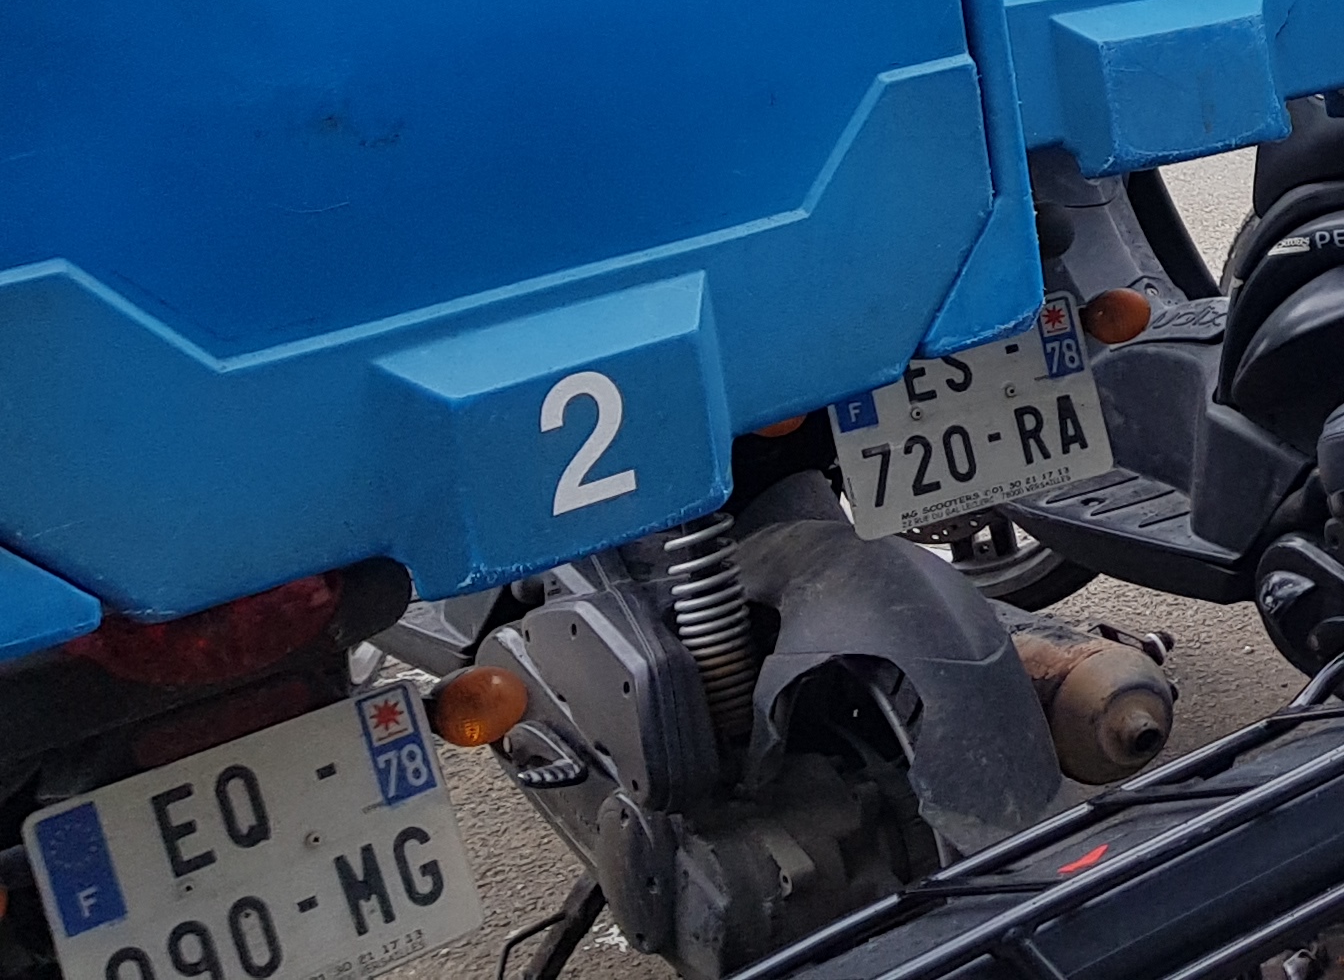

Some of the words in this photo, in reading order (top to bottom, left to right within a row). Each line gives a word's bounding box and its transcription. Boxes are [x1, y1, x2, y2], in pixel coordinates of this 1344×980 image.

[1045, 338, 1077, 374] 78
[539, 370, 637, 517] 2
[861, 394, 1089, 508] 720-RA
[900, 510, 919, 522] MG
[922, 492, 980, 514] SCOOTERS
[378, 742, 428, 798] 78
[151, 763, 272, 878] EQ
[76, 887, 98, 918] F
